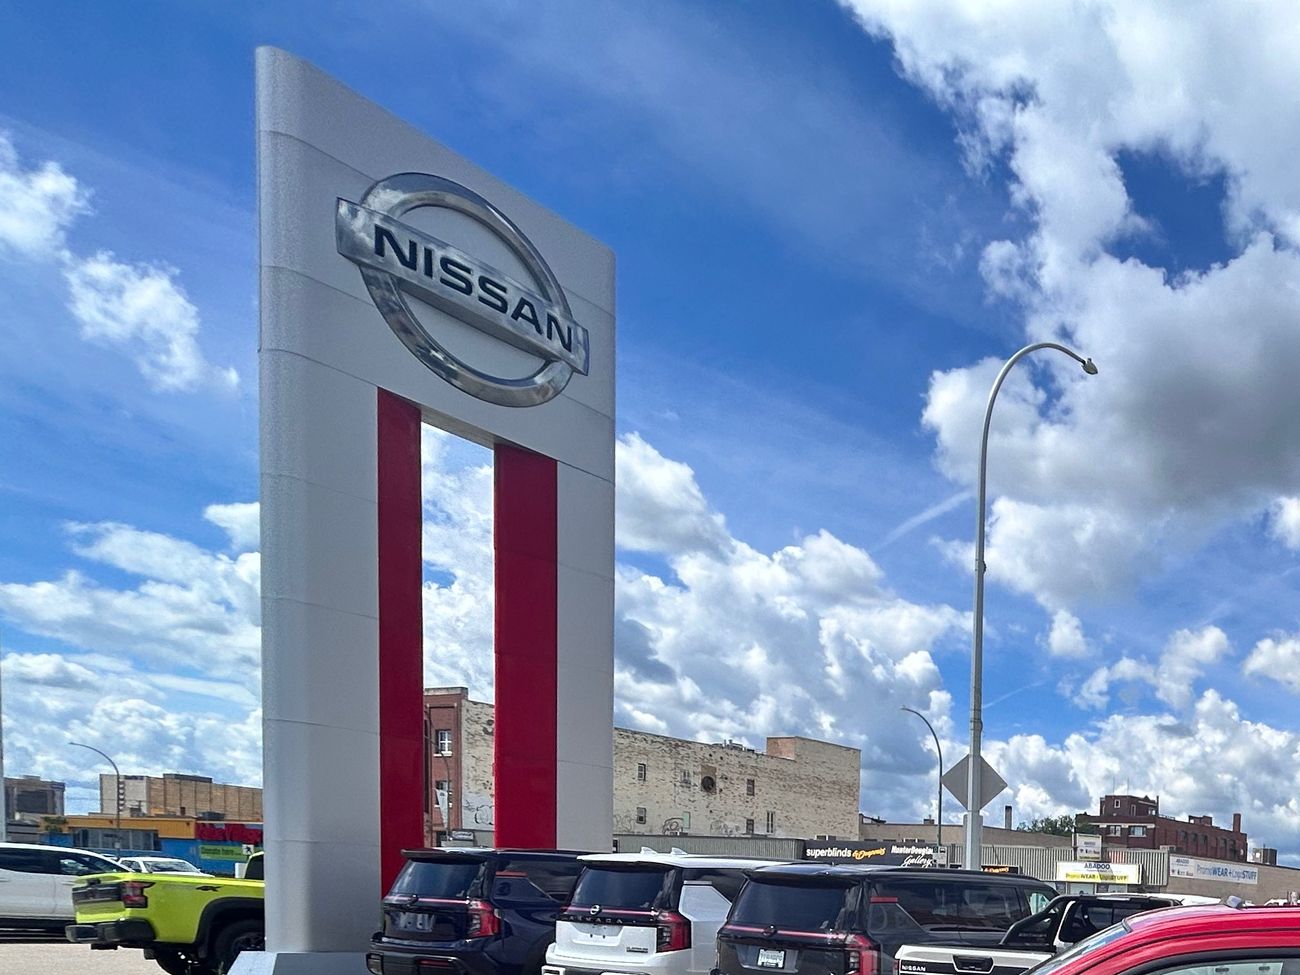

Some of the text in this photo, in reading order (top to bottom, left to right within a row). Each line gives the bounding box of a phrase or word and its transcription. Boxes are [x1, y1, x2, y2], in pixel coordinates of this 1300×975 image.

[374, 223, 573, 354] NISSAN
[806, 847, 852, 858] superblinds
[890, 845, 934, 855] HunterDougla
[900, 854, 933, 868] Gallery
